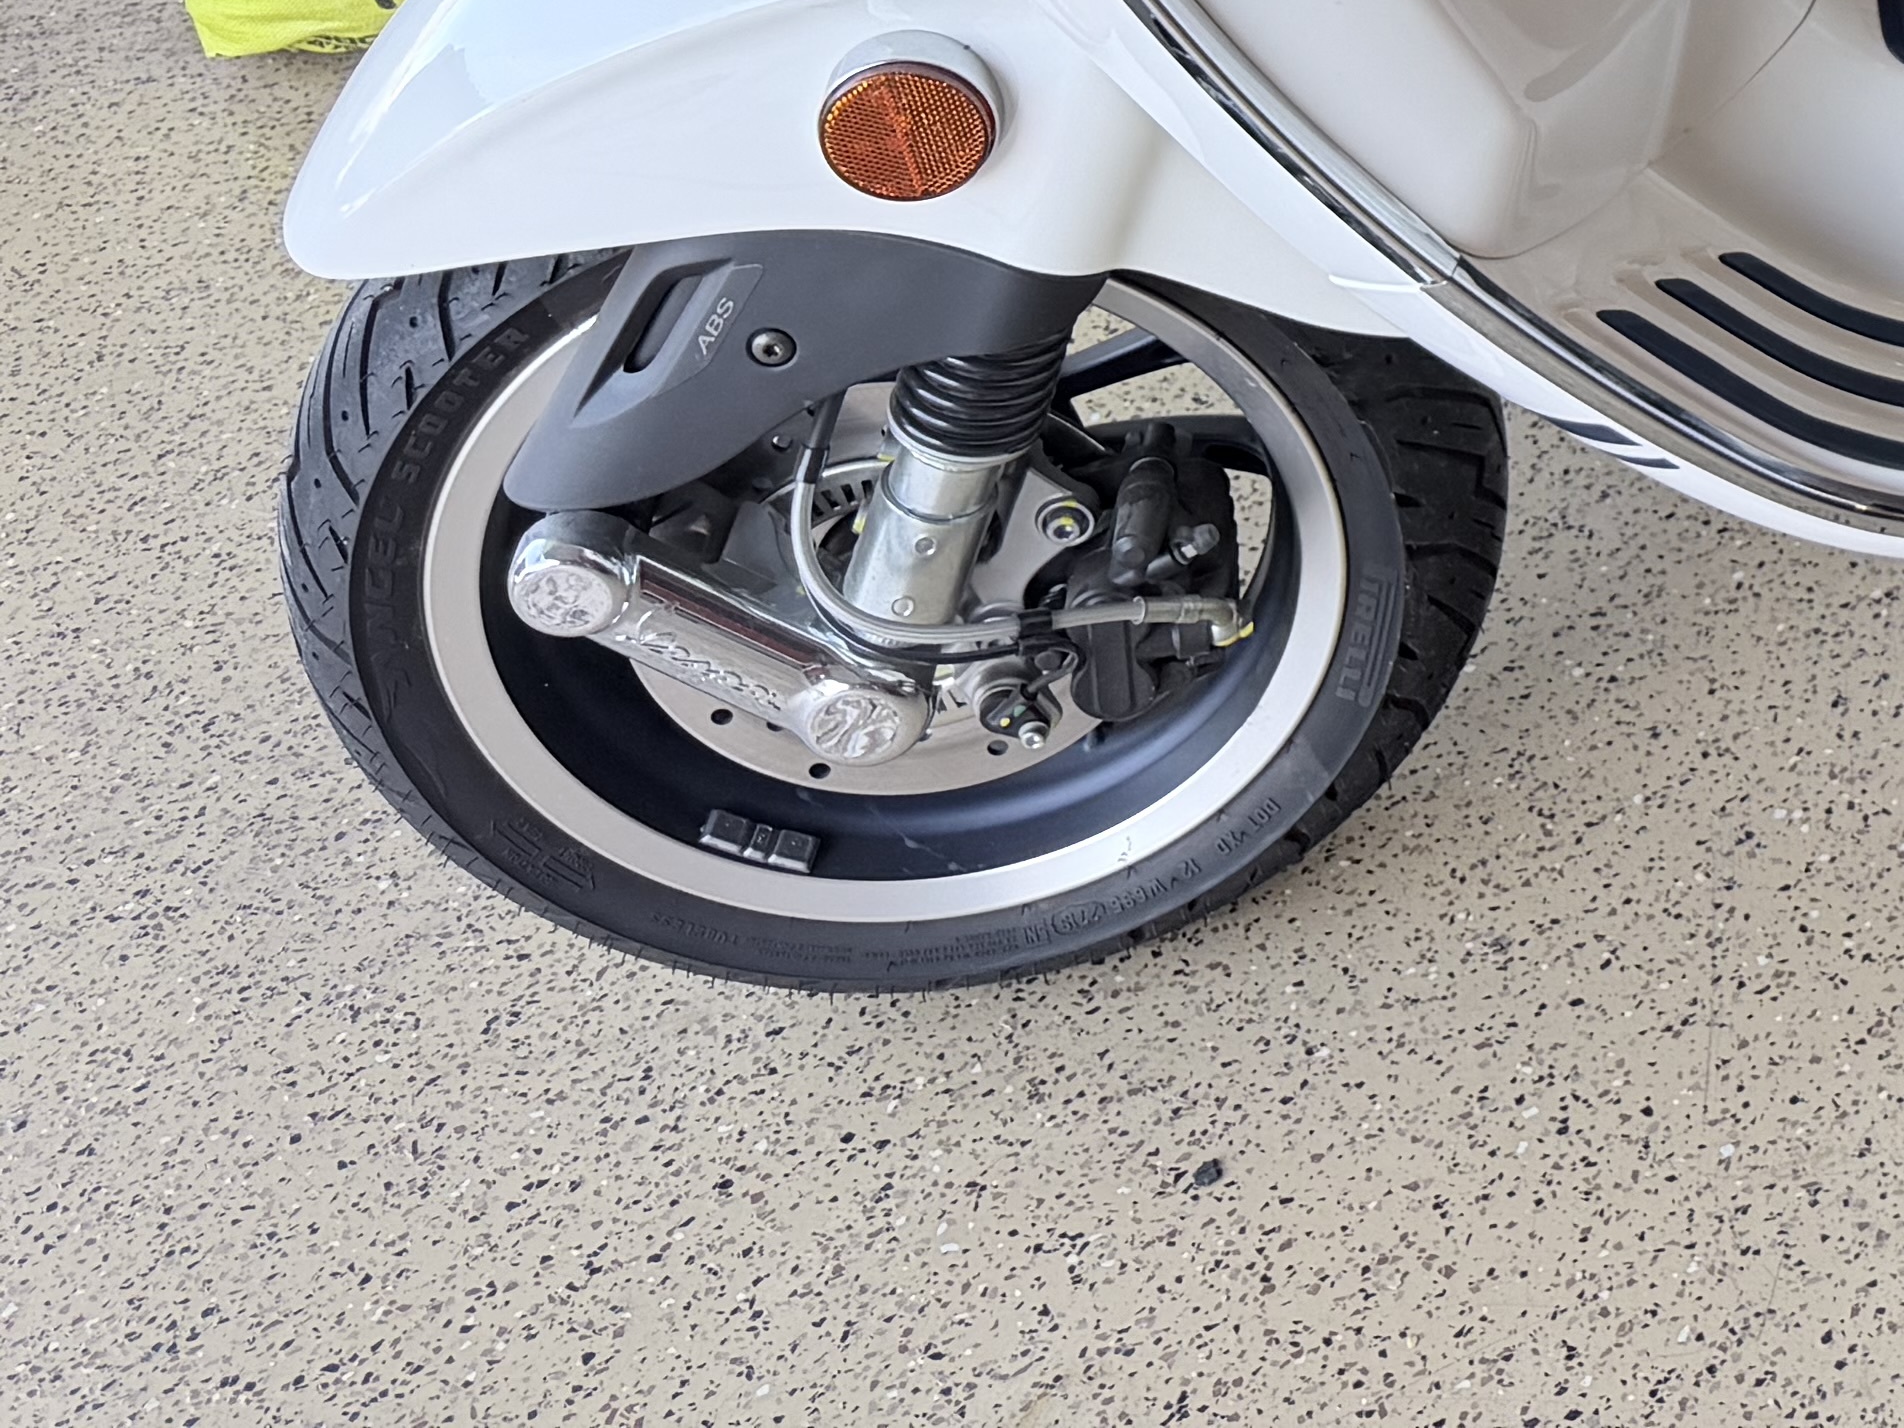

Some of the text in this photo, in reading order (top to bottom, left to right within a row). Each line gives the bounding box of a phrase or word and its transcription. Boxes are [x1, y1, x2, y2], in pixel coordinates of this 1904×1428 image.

[698, 297, 734, 356] ABS
[391, 326, 530, 484] SCOOTER
[1250, 797, 1281, 830] DOT
